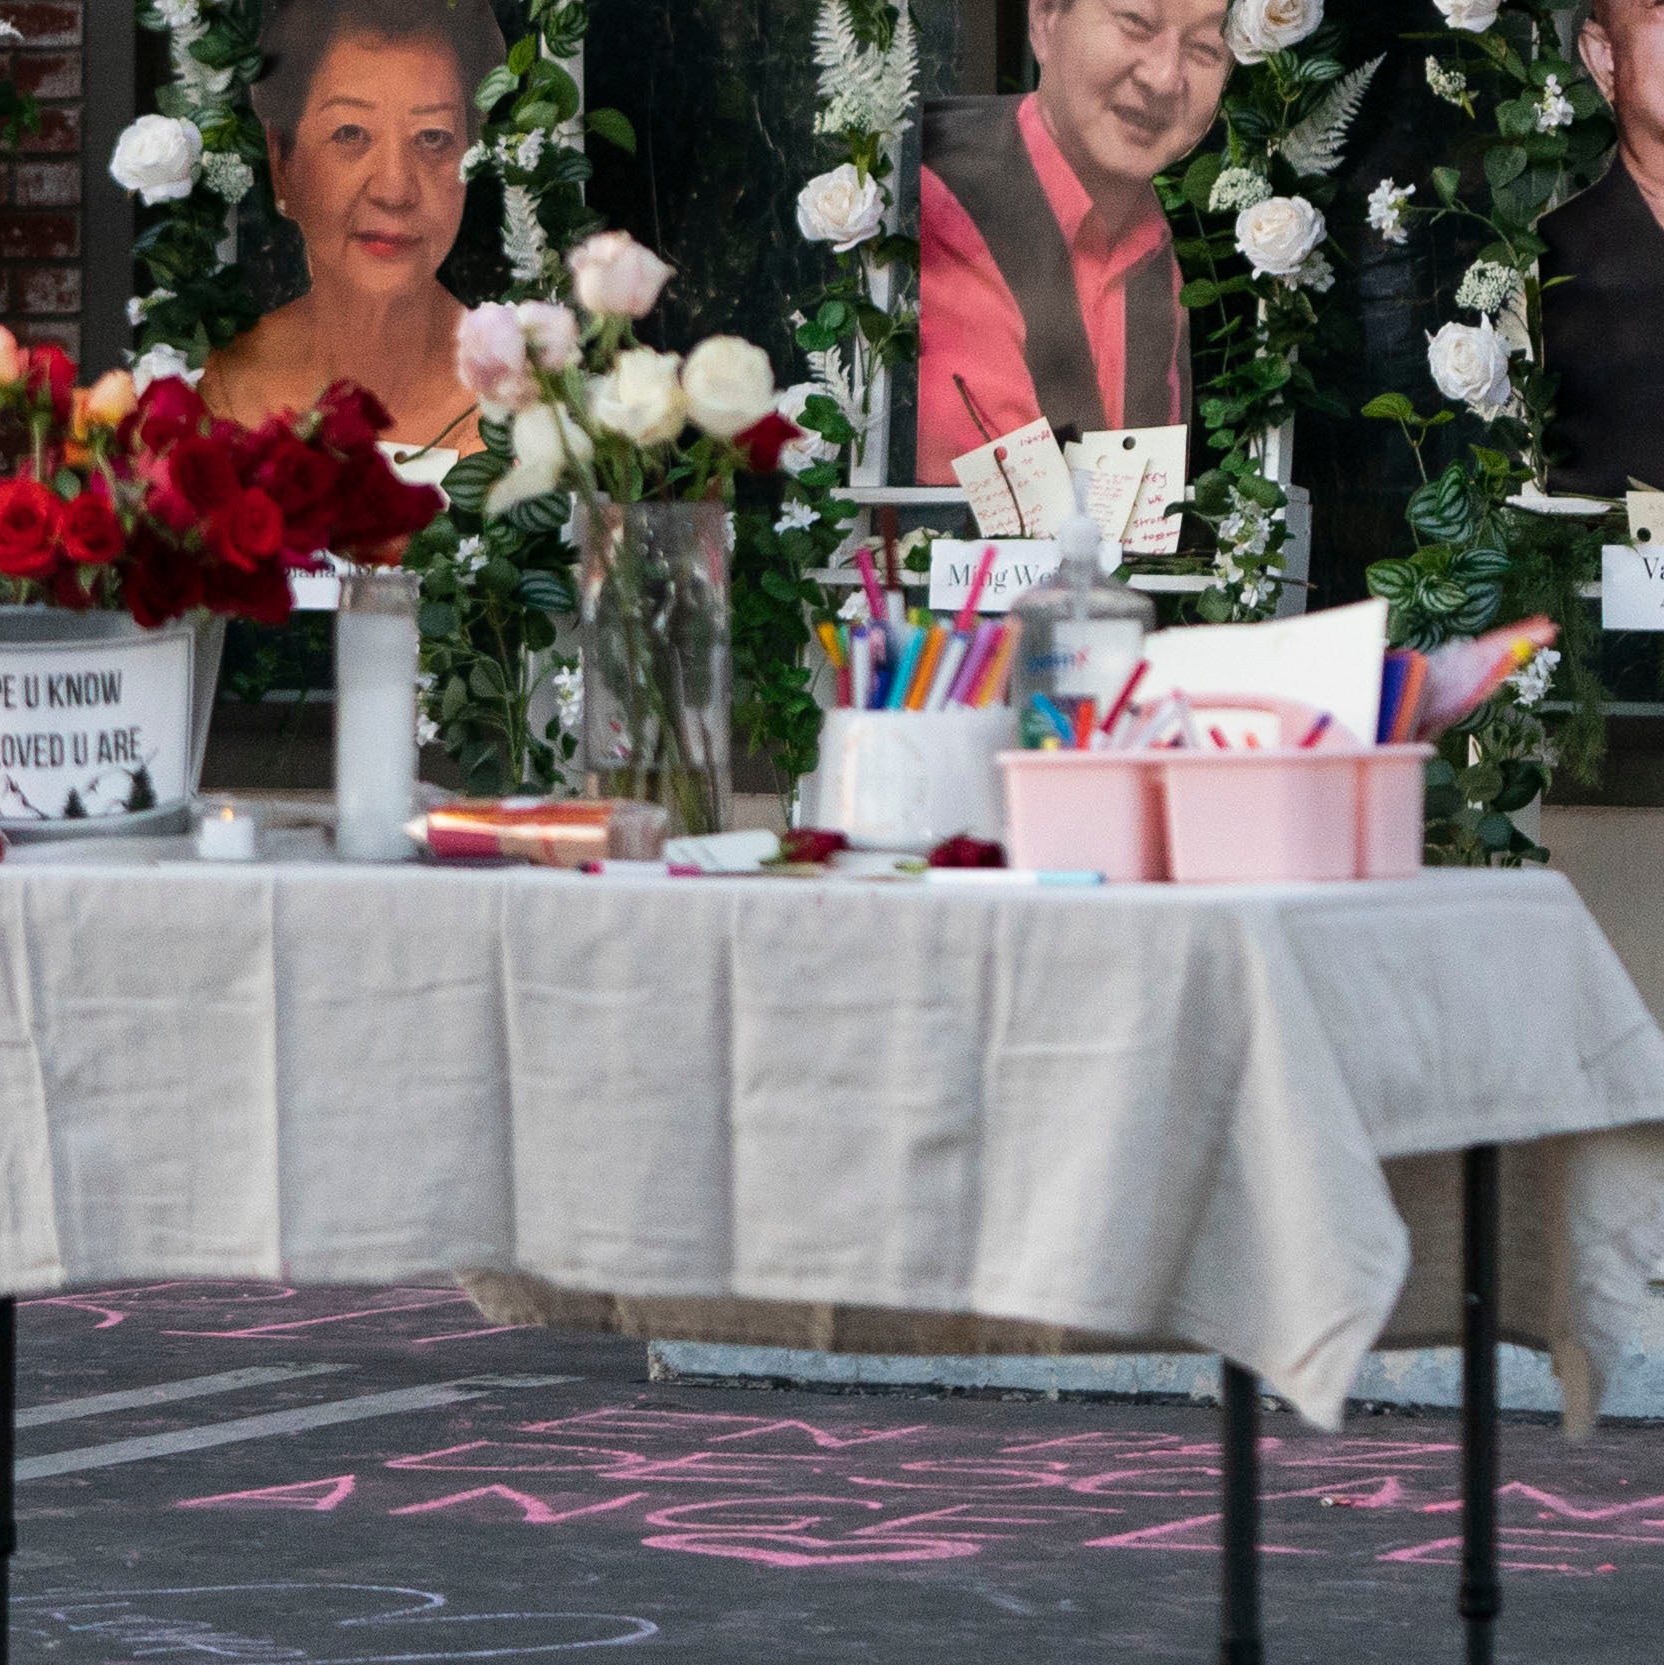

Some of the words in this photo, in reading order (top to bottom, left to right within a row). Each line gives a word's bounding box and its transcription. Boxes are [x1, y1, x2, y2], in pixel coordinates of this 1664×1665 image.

[24, 670, 39, 709] U
[48, 669, 123, 709] KNOW
[74, 729, 88, 766] U
[97, 725, 143, 765] ARE
[519, 1408, 927, 1449] EN
